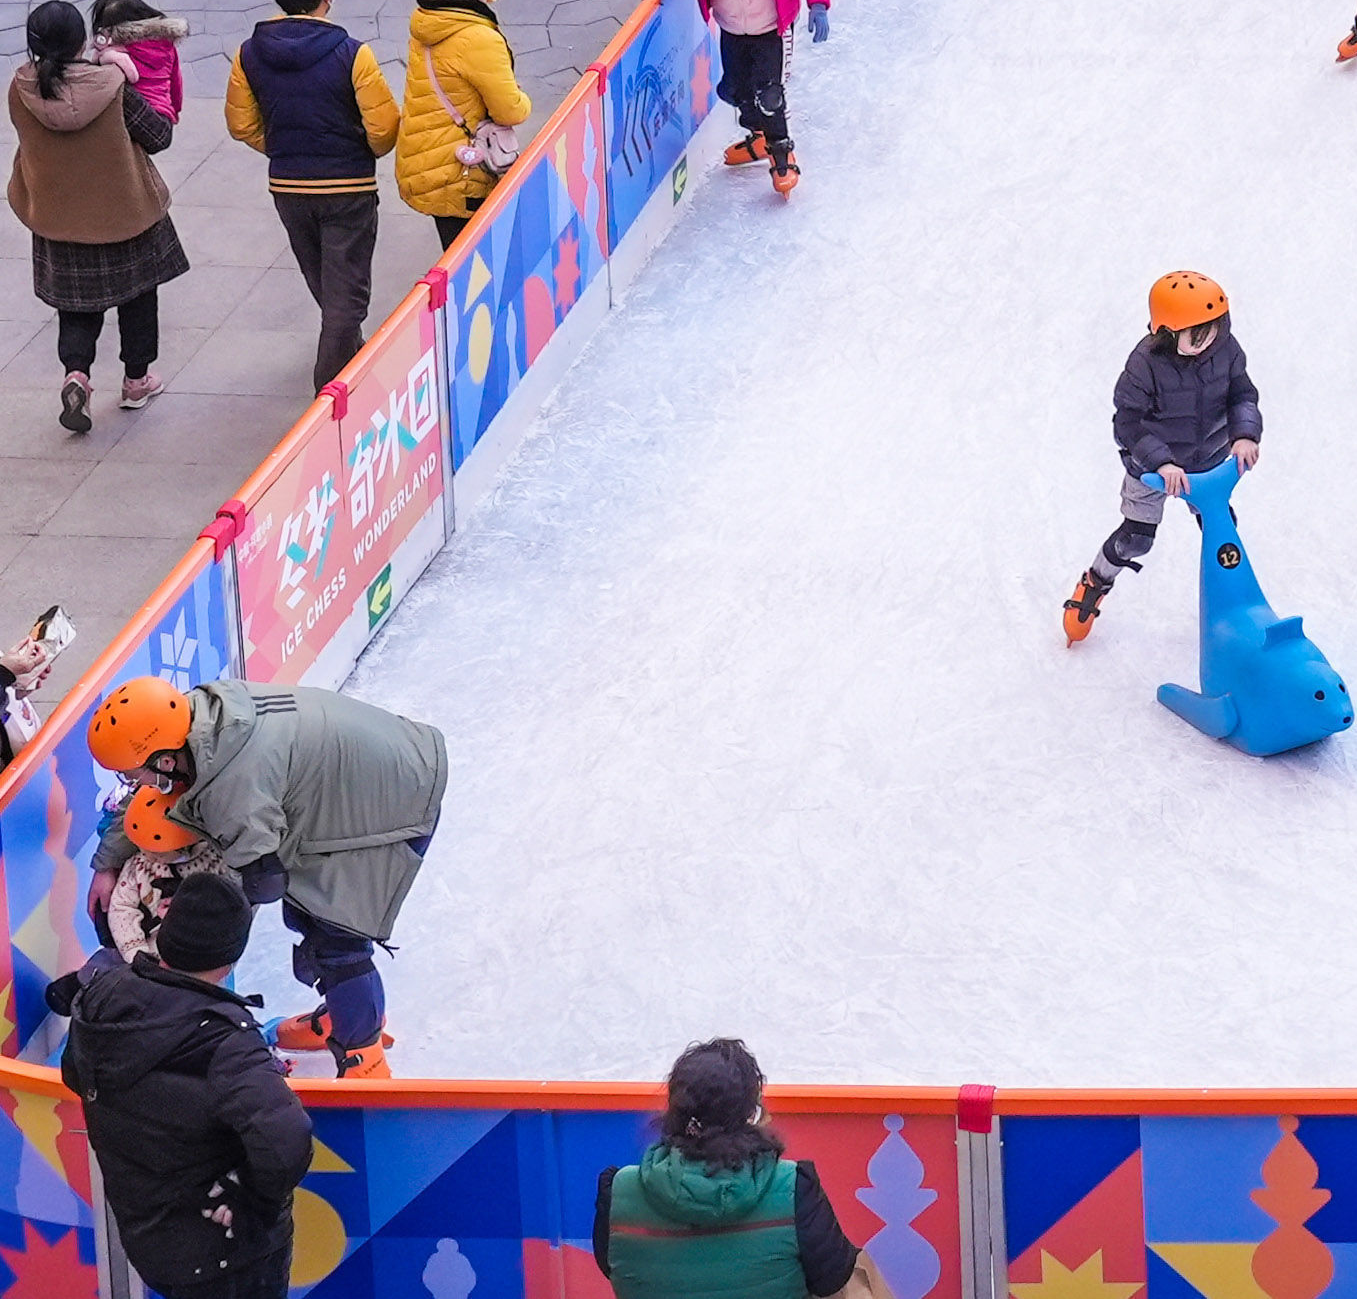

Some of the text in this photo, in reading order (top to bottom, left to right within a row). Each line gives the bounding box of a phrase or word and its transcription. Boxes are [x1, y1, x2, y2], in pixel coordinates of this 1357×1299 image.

[277, 470, 340, 610] 冬梦
[281, 451, 438, 664] ICE CHESS WONDERLAND
[1221, 549, 1239, 567] 12
